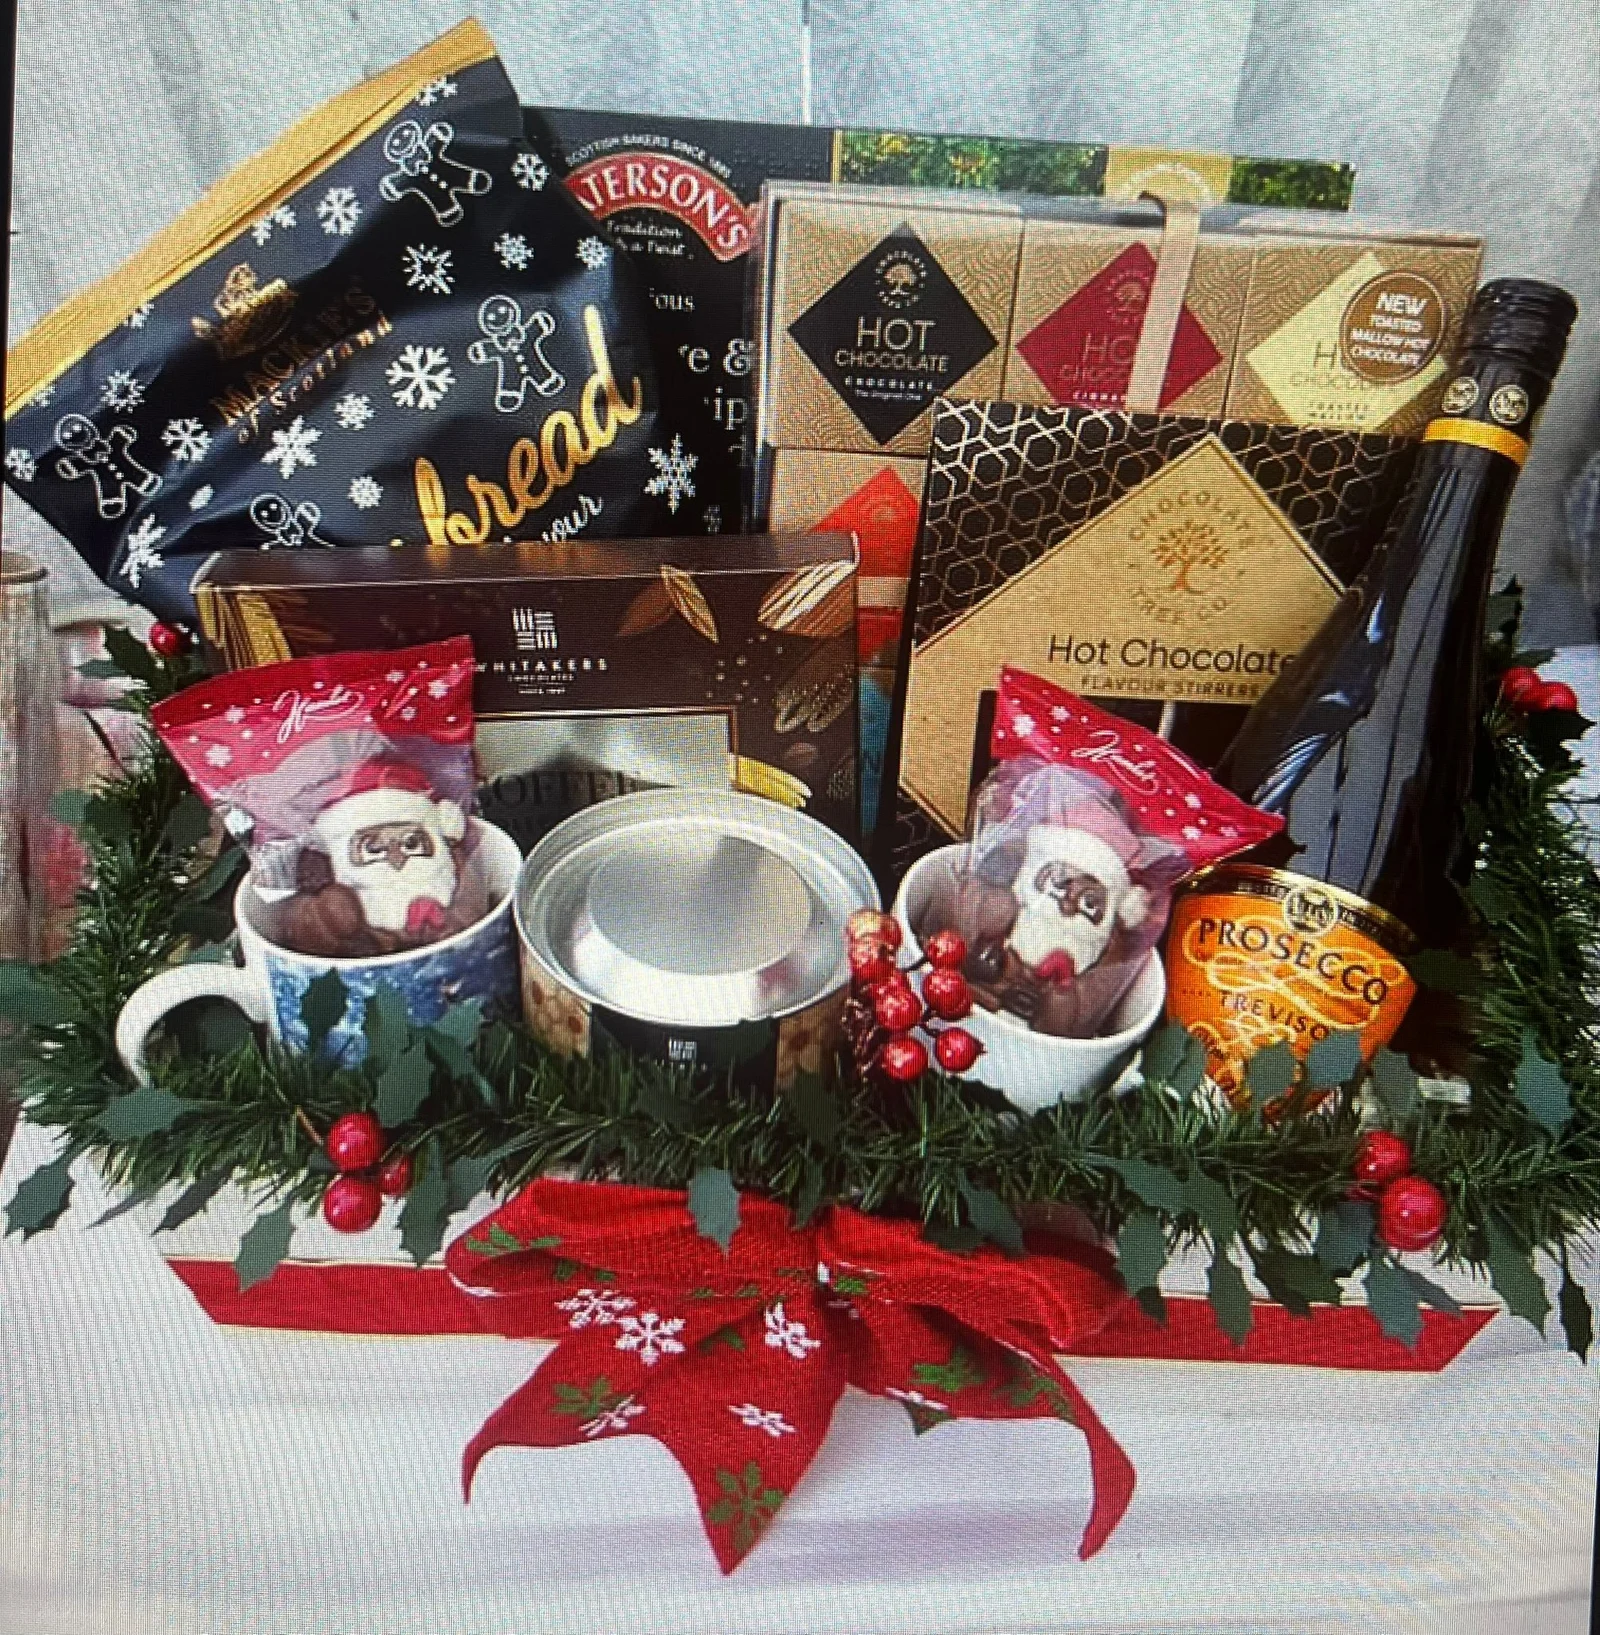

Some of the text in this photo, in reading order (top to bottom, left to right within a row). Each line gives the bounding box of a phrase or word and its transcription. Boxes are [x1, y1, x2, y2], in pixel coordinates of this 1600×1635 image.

[1375, 291, 1429, 315] NEW
[857, 316, 936, 351] HOT
[1082, 332, 1138, 364] HO
[834, 349, 950, 372] CHOCOLATE
[1049, 634, 1111, 665] Hot
[1080, 676, 1165, 692] FLAVOUR
[1196, 916, 1388, 1006] PROSECCO
[1220, 989, 1331, 1042] TREVISO
